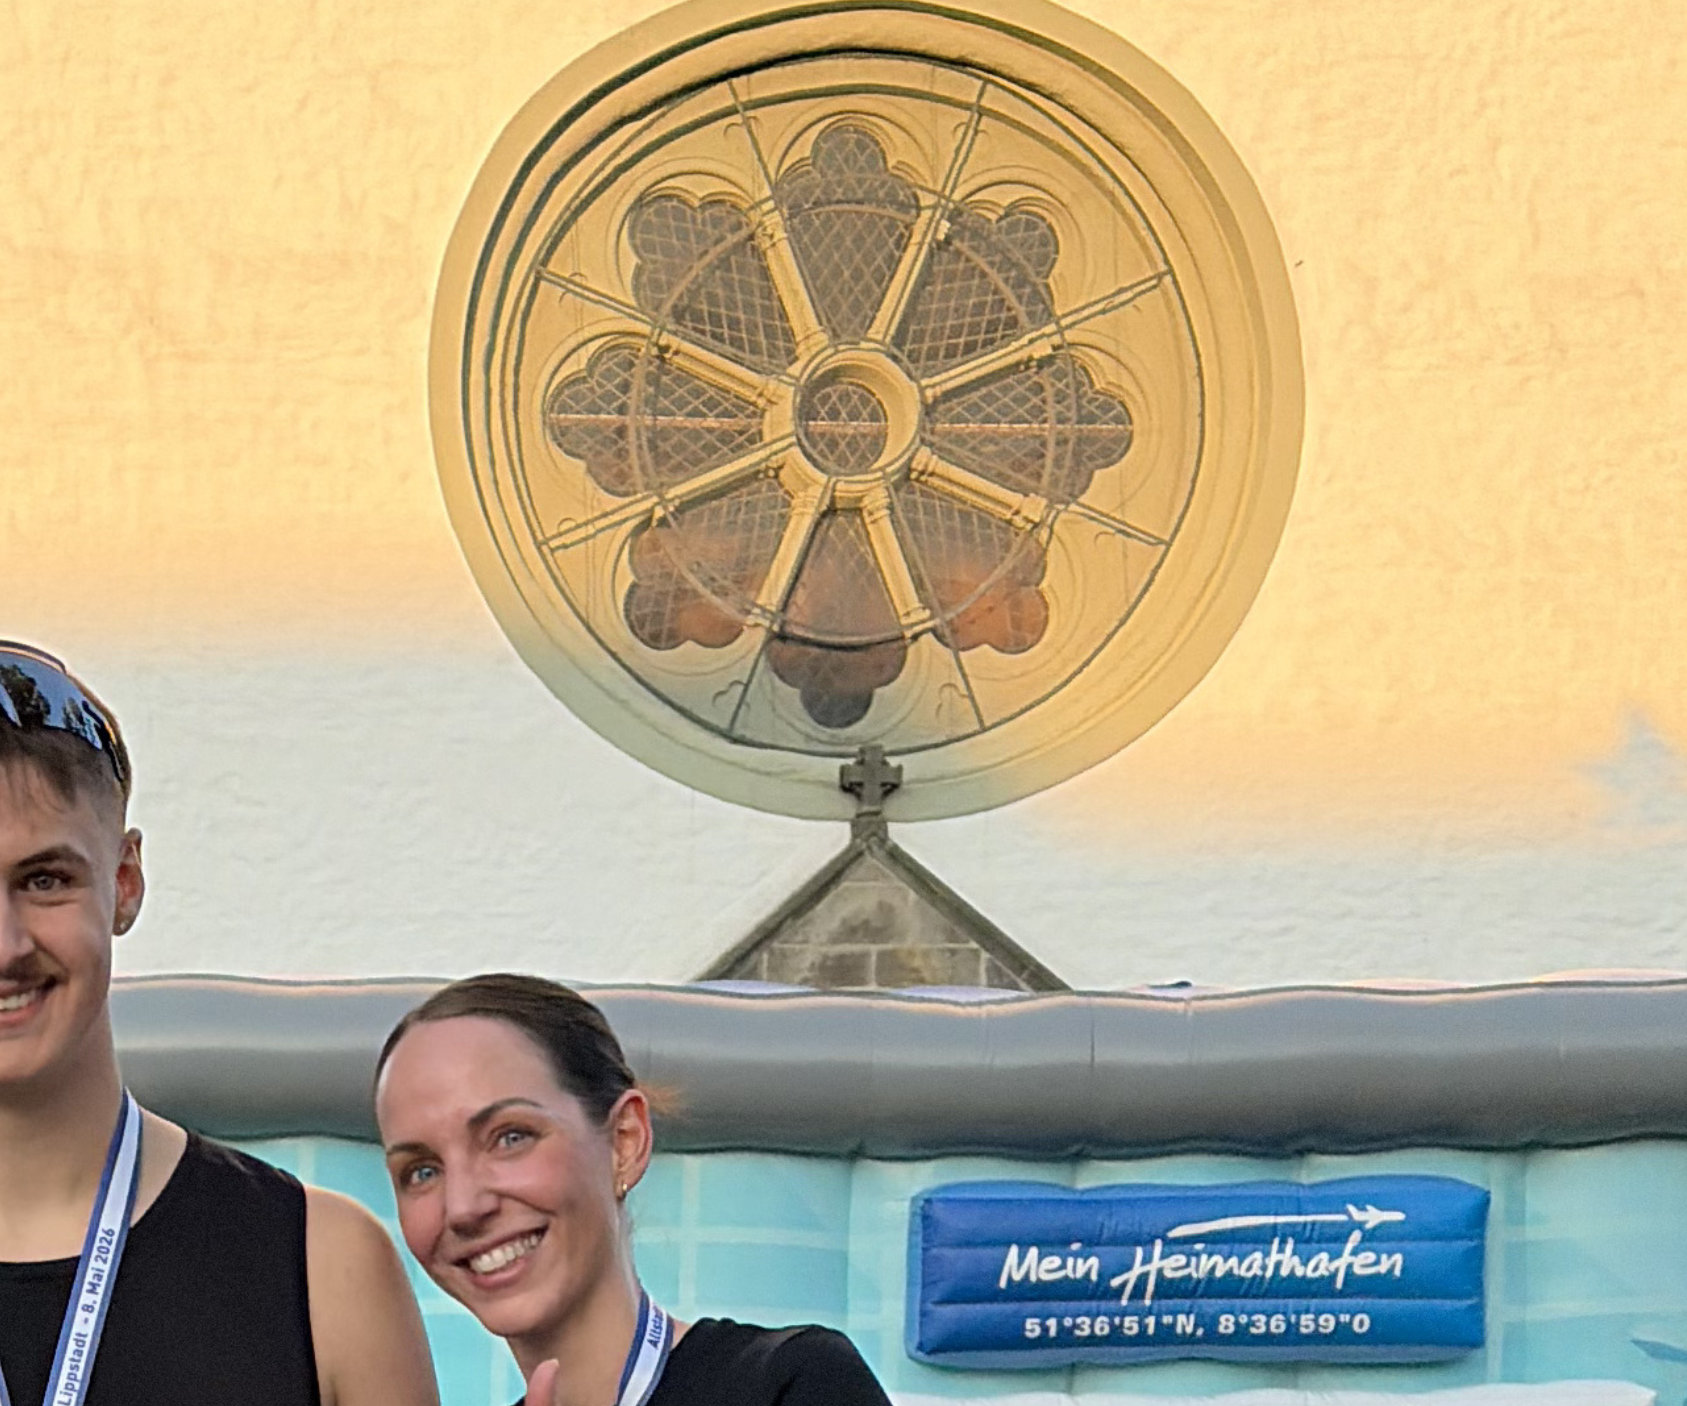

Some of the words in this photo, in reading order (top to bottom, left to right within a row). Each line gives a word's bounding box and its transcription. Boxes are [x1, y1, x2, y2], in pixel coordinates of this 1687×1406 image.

[94, 1228, 115, 1264] 2026
[85, 1266, 105, 1296] Mai
[998, 1243, 1099, 1290] Mein
[1110, 1230, 1404, 1305] Heimathafen
[81, 1300, 98, 1313] 8.
[57, 1331, 89, 1406] Lippstadt
